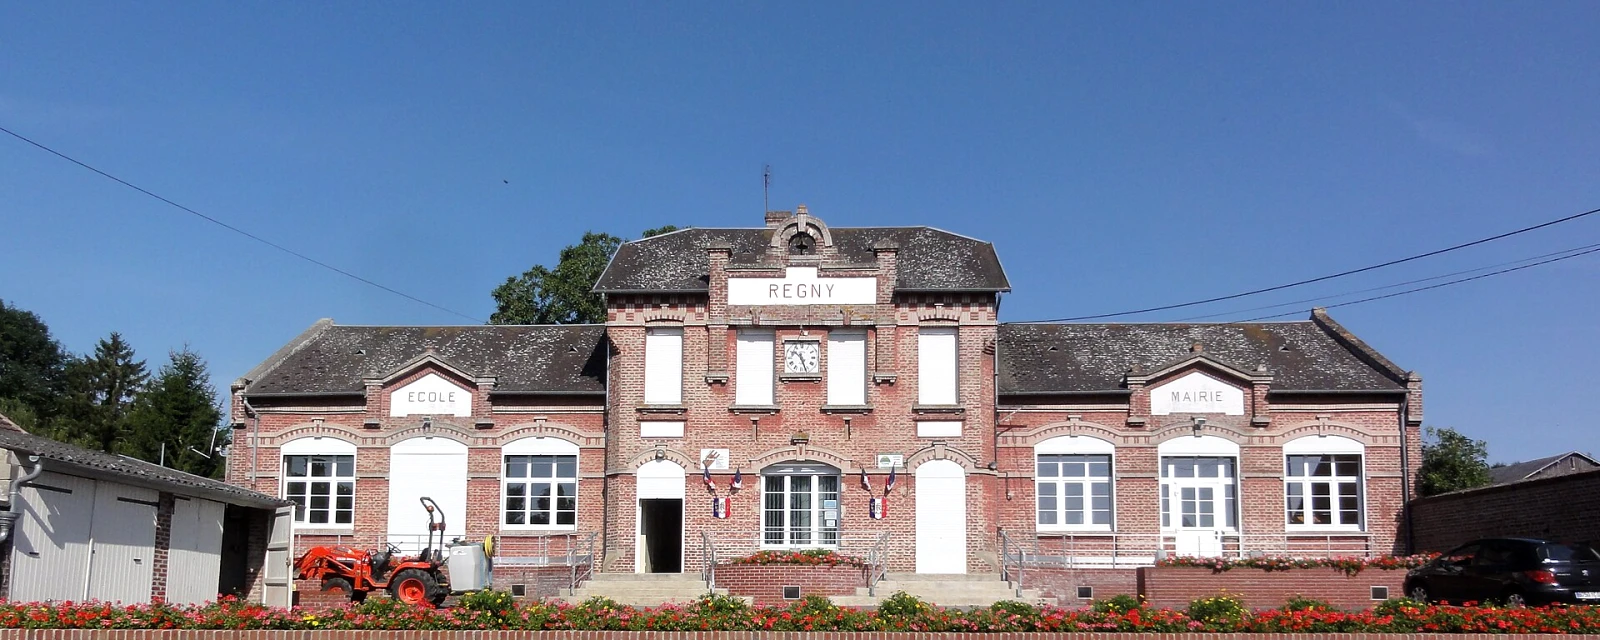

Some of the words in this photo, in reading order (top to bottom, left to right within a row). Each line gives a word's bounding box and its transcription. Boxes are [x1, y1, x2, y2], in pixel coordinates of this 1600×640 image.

[769, 283, 835, 298] REGNY
[408, 391, 456, 403] ECOLE
[1171, 391, 1223, 402] MAIRIE
